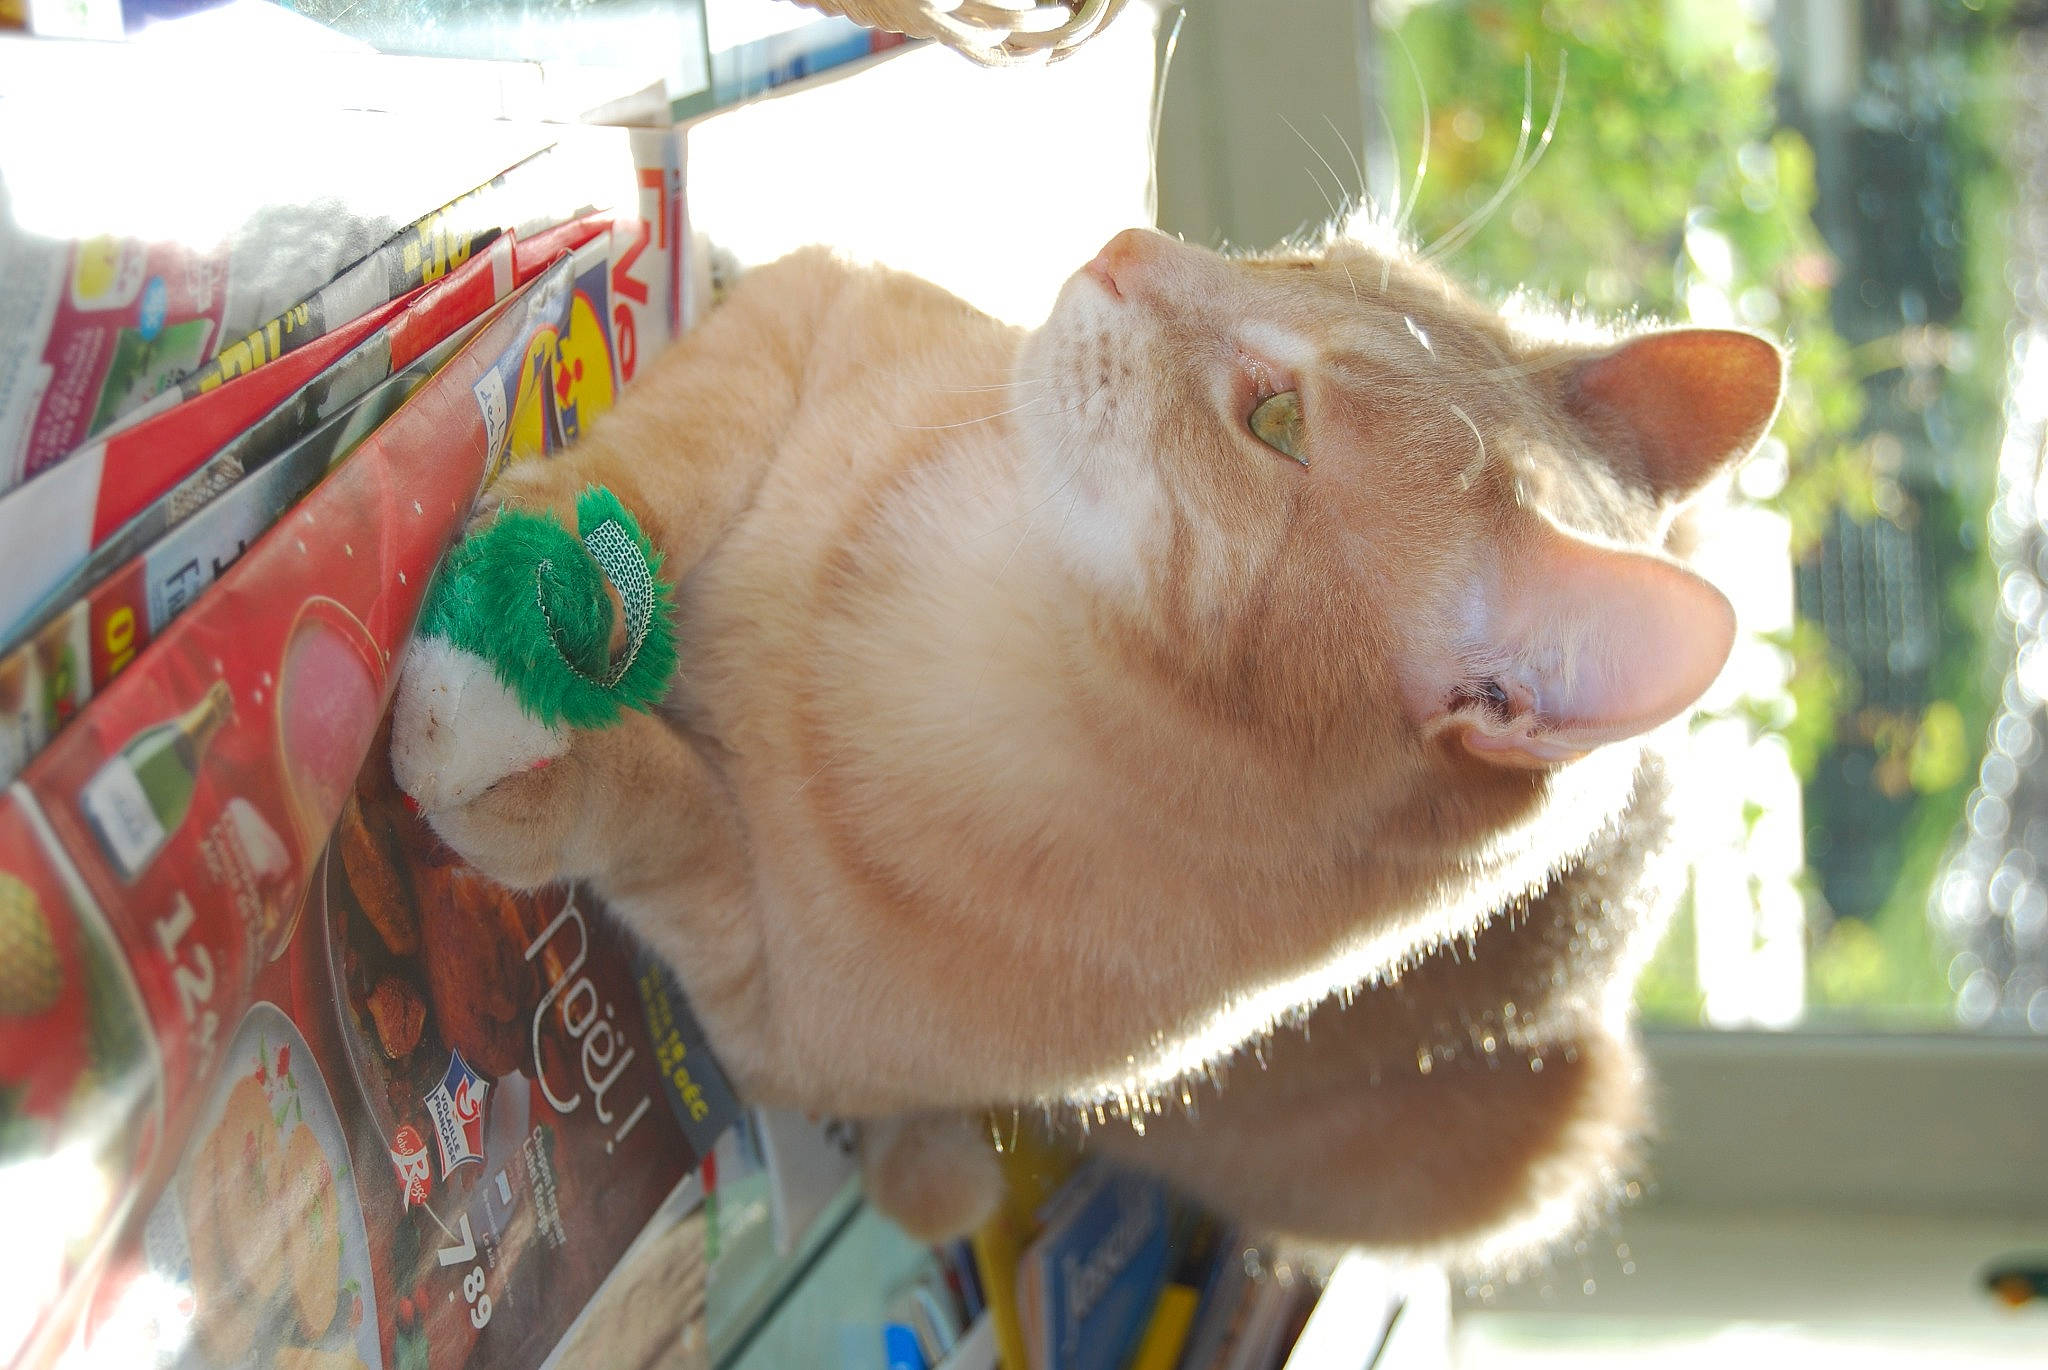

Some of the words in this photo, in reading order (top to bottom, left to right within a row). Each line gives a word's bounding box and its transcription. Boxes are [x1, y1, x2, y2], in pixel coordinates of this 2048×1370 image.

[396, 1131, 414, 1156] label
[435, 1096, 457, 1164] FRANÇAISE
[440, 1094, 460, 1152] VOLAILLE
